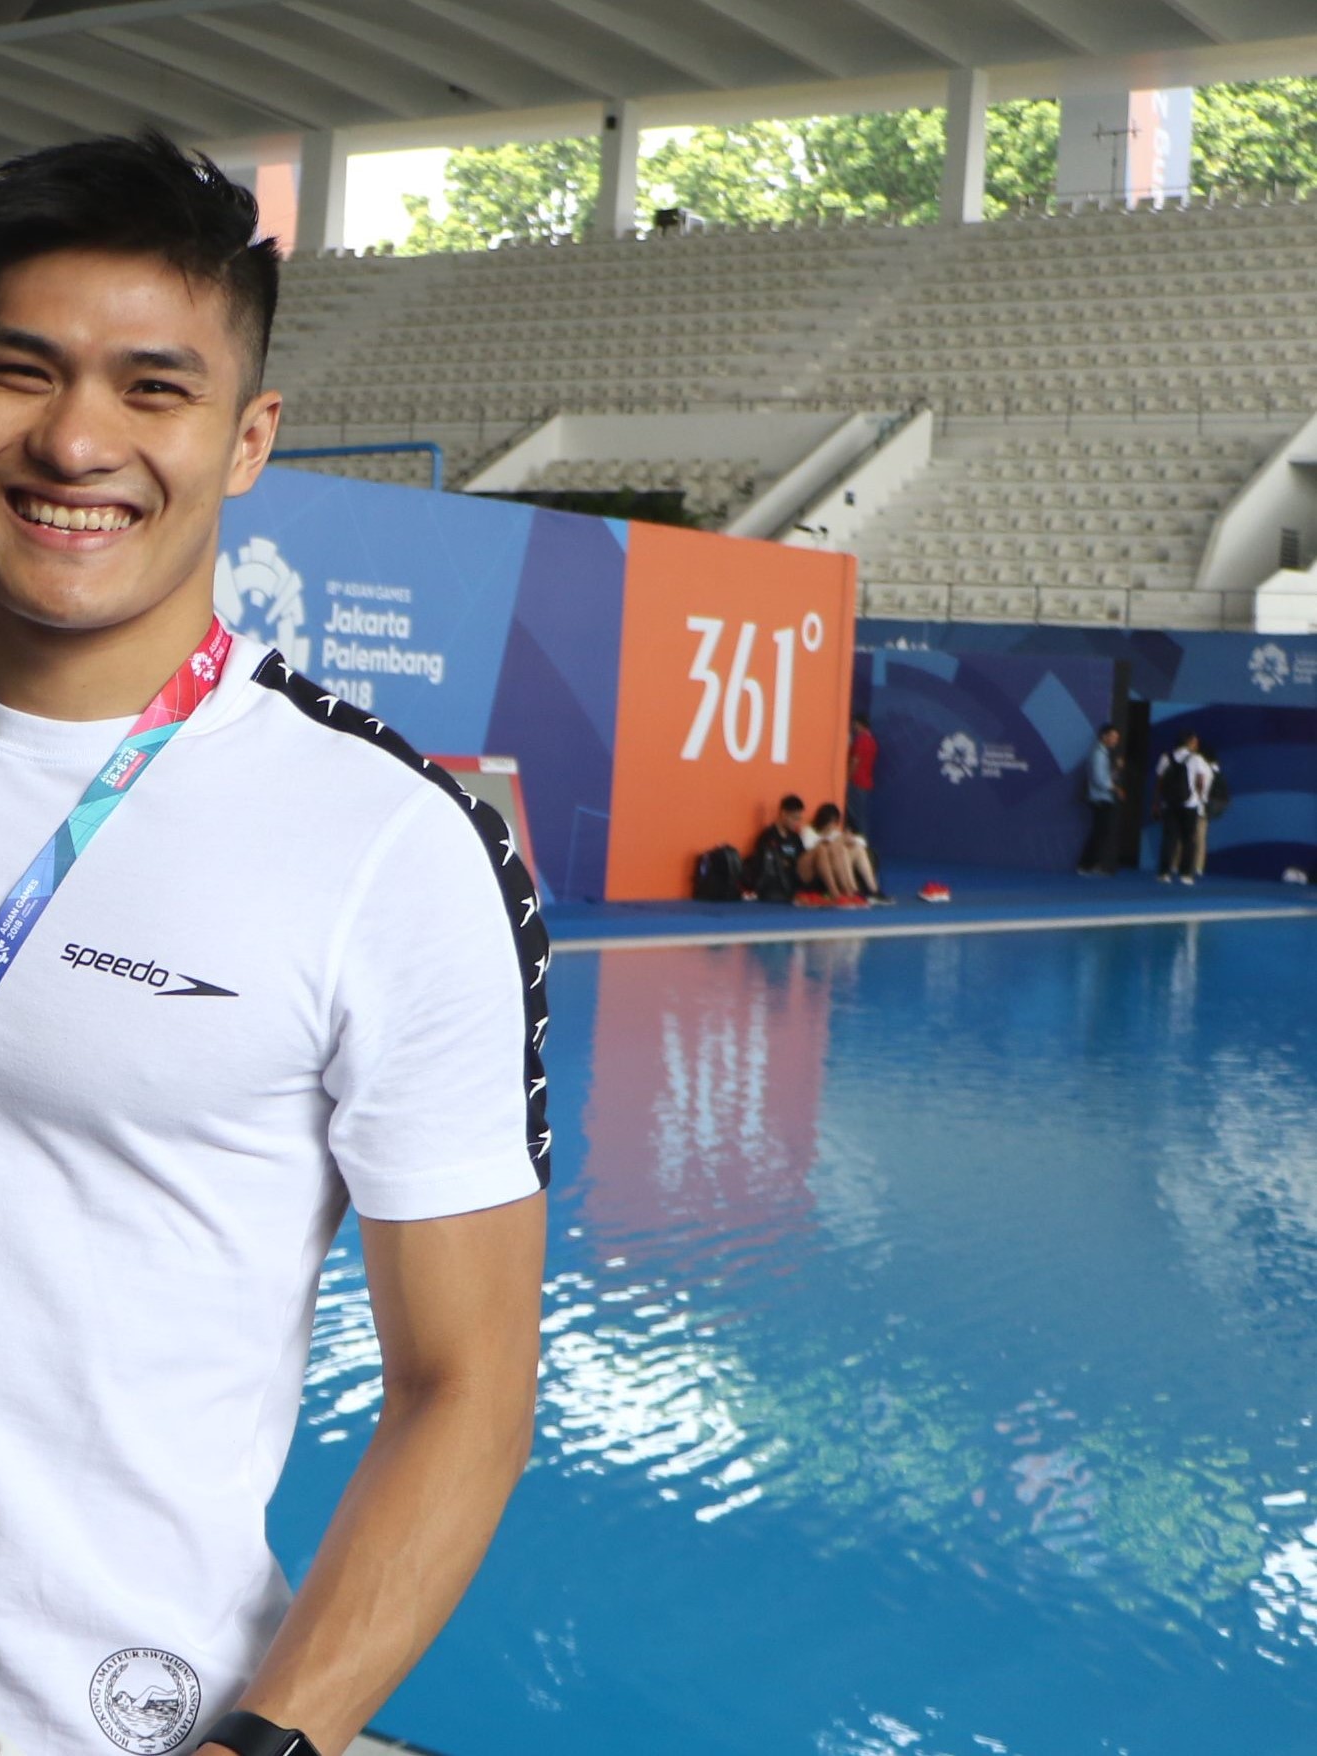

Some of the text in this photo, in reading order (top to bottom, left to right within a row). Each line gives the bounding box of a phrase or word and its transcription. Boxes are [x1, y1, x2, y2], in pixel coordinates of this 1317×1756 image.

[324, 602, 411, 639] Jakarta
[323, 638, 443, 685] Palembang
[681, 611, 824, 764] 361°
[0, 907, 20, 935] ASIAN
[15, 879, 40, 909] GAMES
[6, 919, 24, 941] 2018
[60, 943, 170, 988] speedo
[95, 1650, 140, 1686] AMATEUR
[142, 1650, 195, 1682] SWIMMING
[162, 1683, 198, 1750] ASSOCIATION
